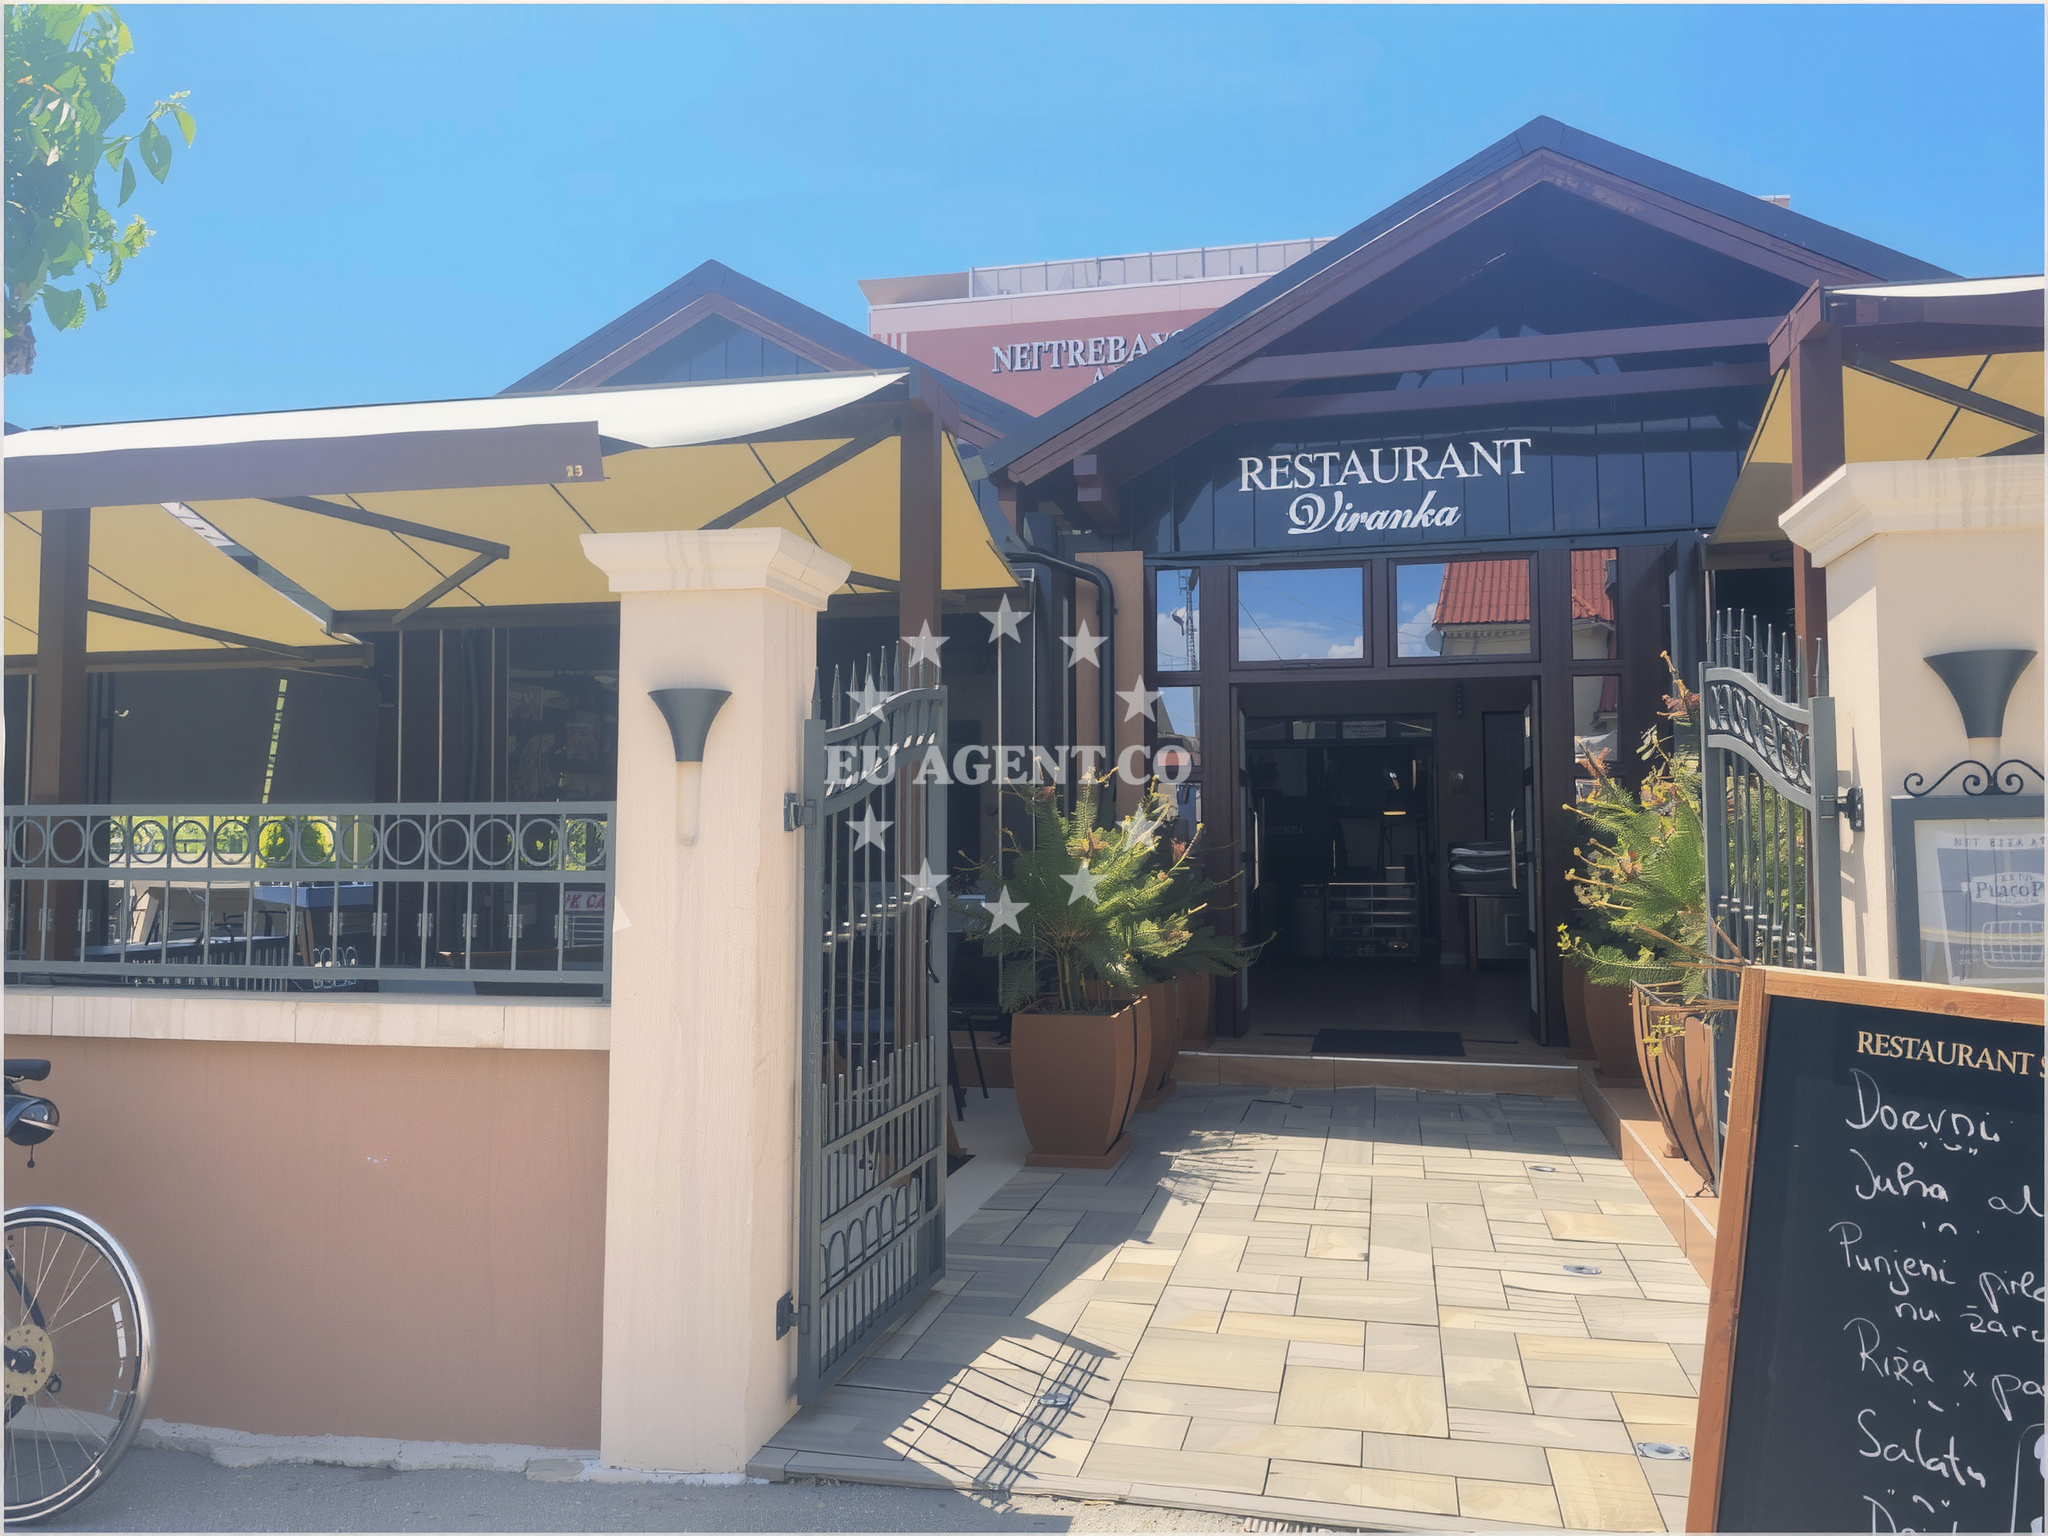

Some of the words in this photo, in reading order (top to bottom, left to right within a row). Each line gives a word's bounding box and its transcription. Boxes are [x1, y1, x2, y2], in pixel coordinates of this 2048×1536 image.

[1238, 438, 1531, 492] RESTAURANT
[1287, 490, 1462, 534] Viranka
[1857, 1030, 2035, 1075] RESTAURANT
